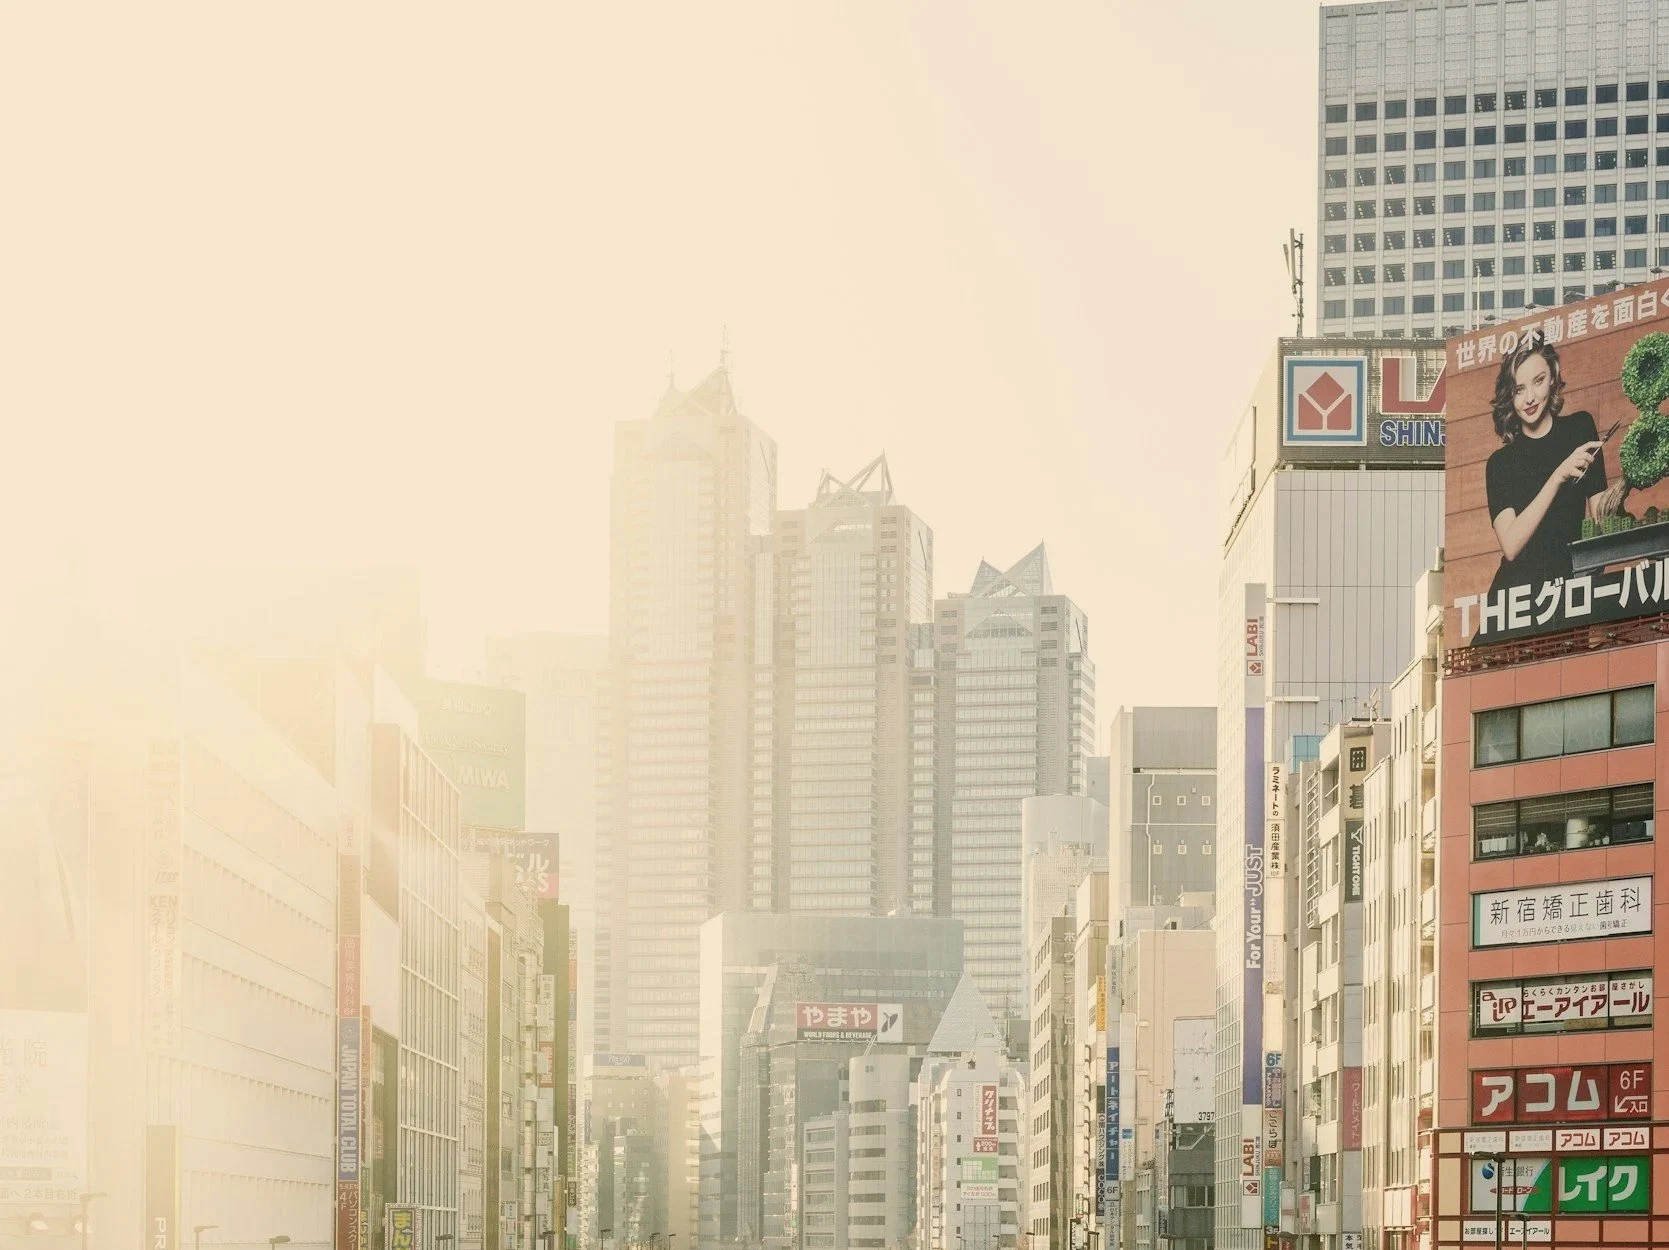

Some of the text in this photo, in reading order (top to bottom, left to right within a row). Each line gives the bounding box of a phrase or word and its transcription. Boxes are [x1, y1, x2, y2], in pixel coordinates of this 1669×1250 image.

[1246, 618, 1258, 657] LABI
[1245, 844, 1263, 968] For Your JUST
[1490, 886, 1641, 925] 新宿矯正歯科
[802, 1006, 872, 1028] やまや
[1522, 991, 1649, 1020] エーアイアール
[1266, 1053, 1282, 1066] 6F
[1482, 1071, 1600, 1116] アコム
[1620, 1069, 1645, 1090] 6F
[340, 1045, 357, 1173] JAPAN TOTAL CLUB
[984, 1090, 995, 1130] クリナップ
[1629, 1101, 1648, 1114] 入口
[1561, 1132, 1595, 1147] アコム
[1608, 1131, 1645, 1146] アコム
[1243, 1138, 1255, 1177] LABI
[1107, 1186, 1118, 1194] 6F
[1559, 1165, 1638, 1202] レイク
[1266, 1227, 1279, 1235] 3F
